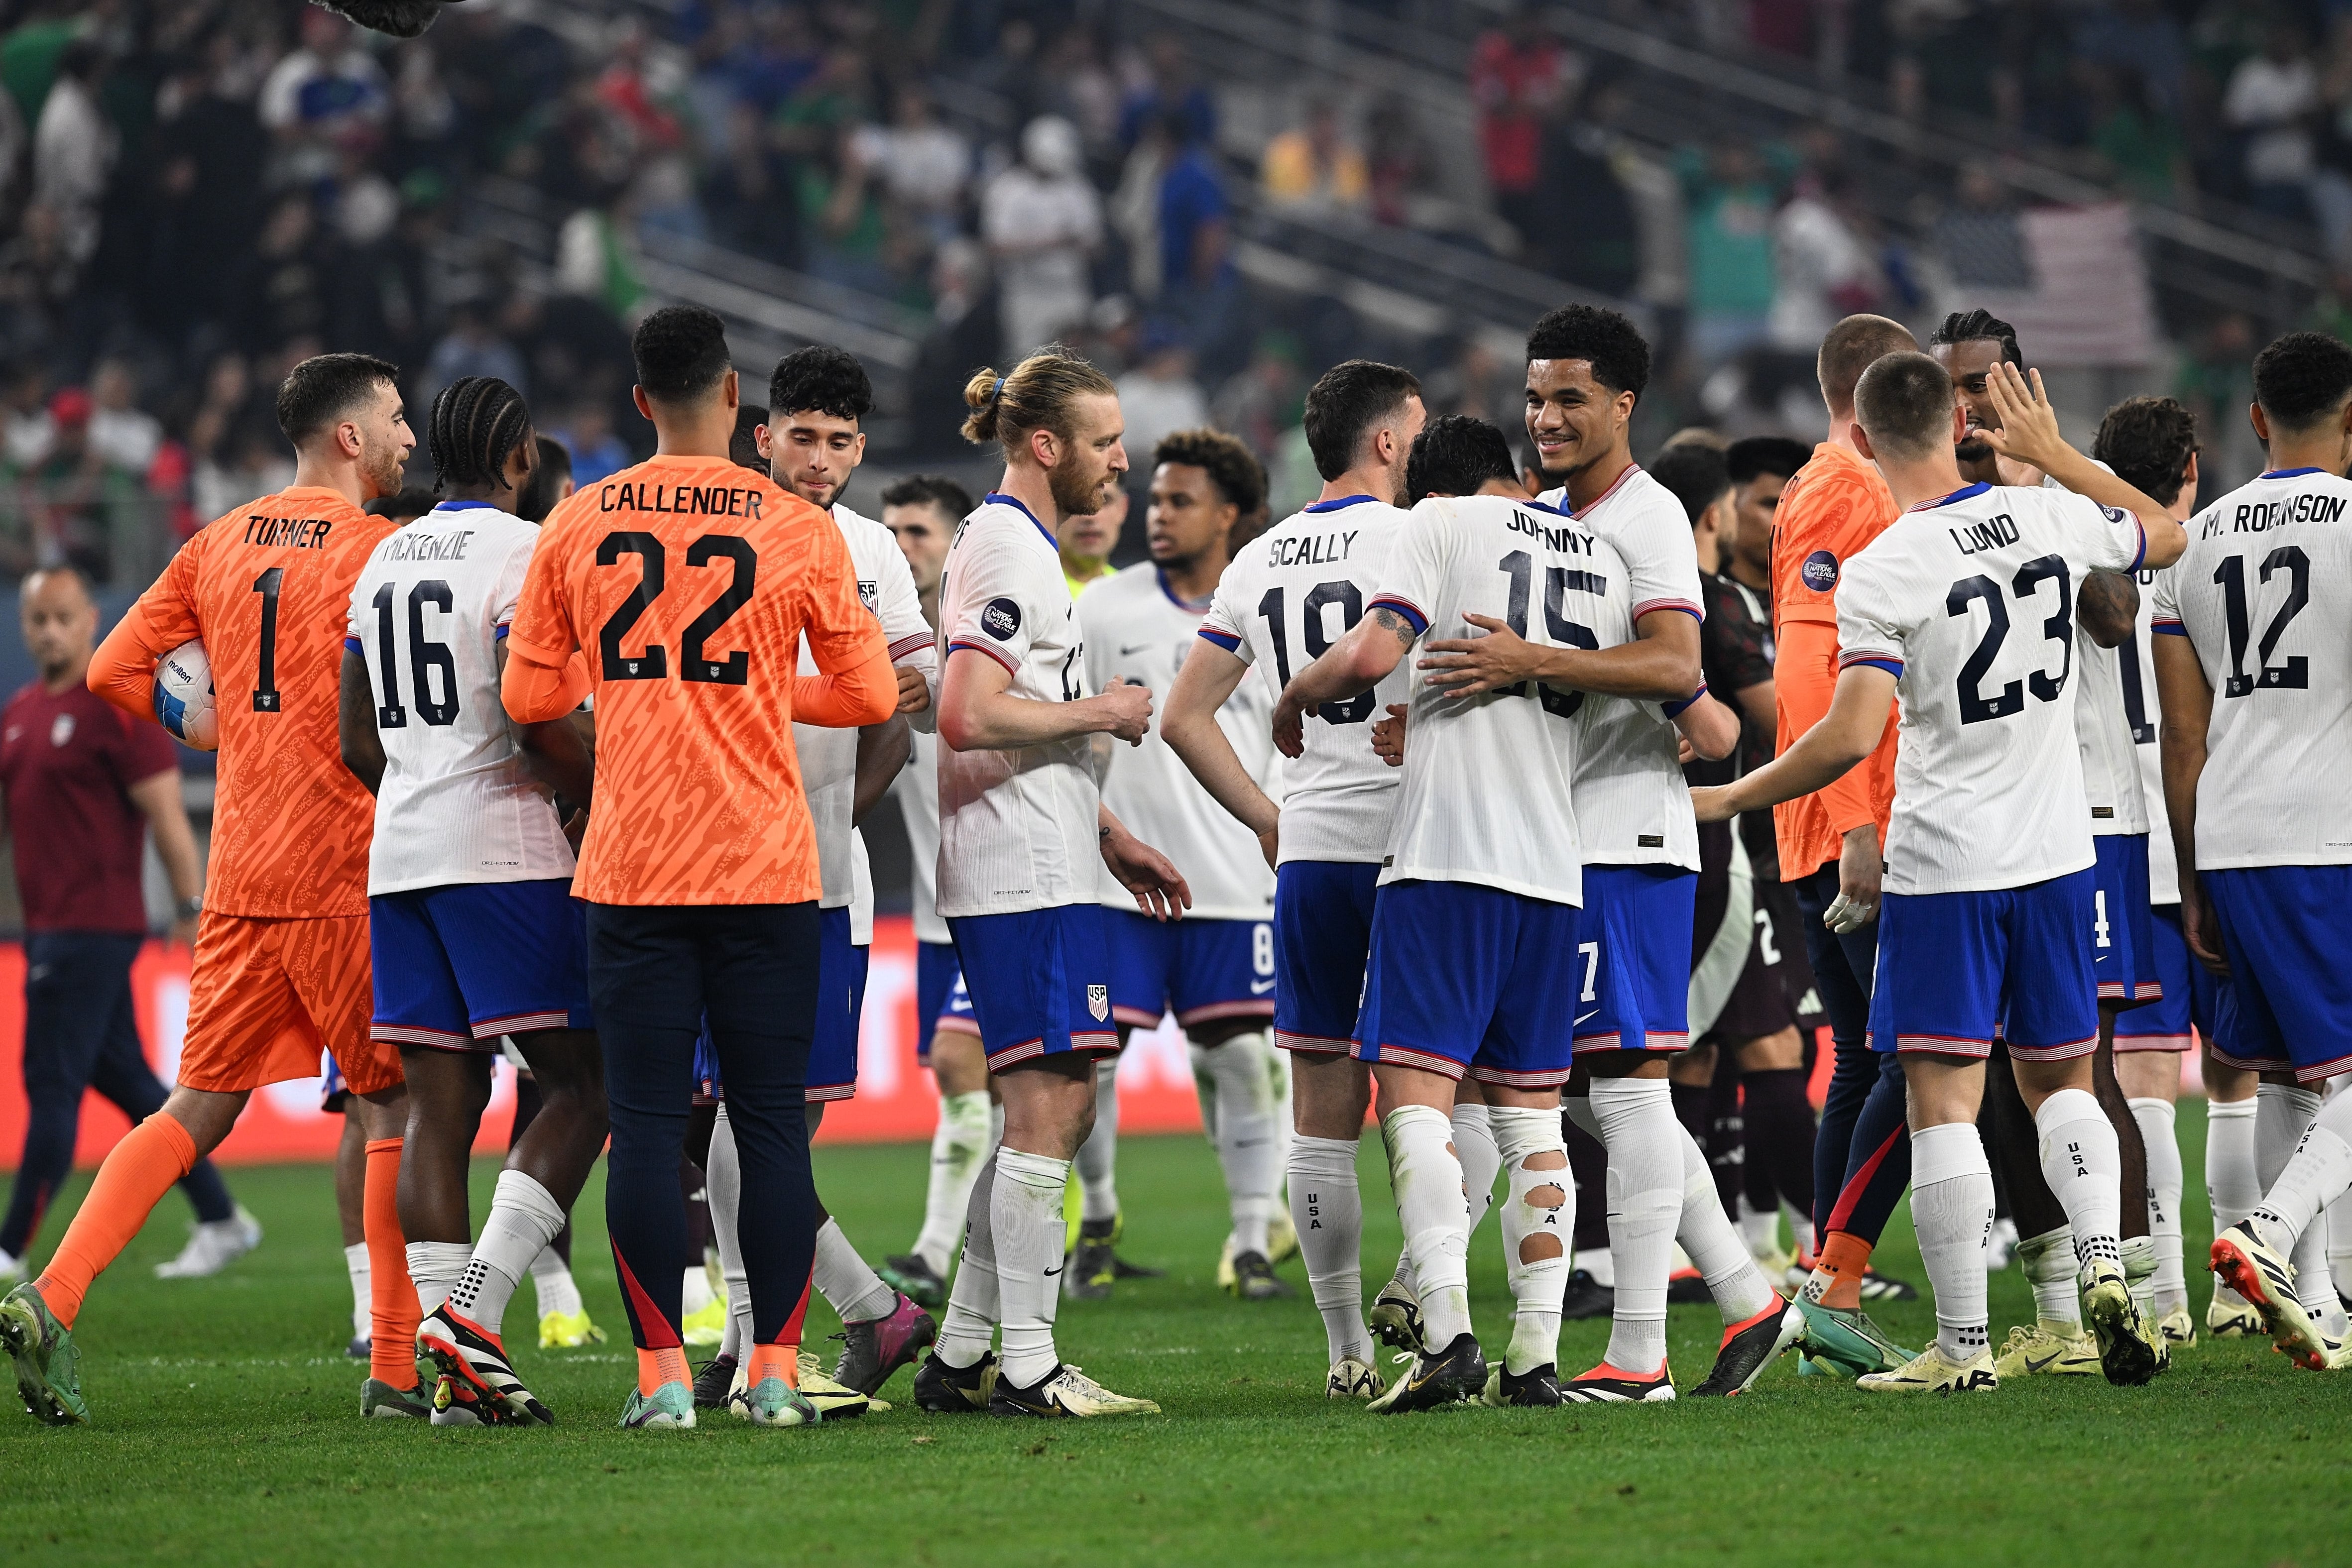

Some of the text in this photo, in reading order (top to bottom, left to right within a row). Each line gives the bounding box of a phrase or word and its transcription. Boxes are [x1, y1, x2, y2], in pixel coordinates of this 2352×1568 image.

[601, 483, 763, 520] CALLENDER
[2202, 494, 2348, 541] M. ROBINSON
[244, 515, 332, 549] TURNER
[1269, 530, 1359, 568] SCALLY
[1507, 509, 1595, 557] JOHNNY
[1949, 513, 2020, 555] LUND
[596, 531, 757, 685] 22
[860, 584, 875, 601] SA
[990, 611, 1014, 624] NATIONS
[996, 618, 1016, 631] LEAGUE
[1001, 627, 1014, 635] FINALS
[1492, 550, 1607, 719] 15
[2214, 546, 2310, 698] 12
[253, 567, 284, 713] 1
[372, 579, 460, 728] 16
[1258, 580, 1377, 730] 19
[1946, 553, 2073, 725] 23
[168, 660, 192, 683] molten
[1252, 923, 1275, 977] 8
[1754, 907, 1782, 966] 2
[1578, 941, 1599, 1003] 7
[1089, 987, 1105, 1001] USA
[2295, 1122, 2317, 1154] USA
[2068, 1142, 2089, 1177] USA
[1308, 1193, 1322, 1230] USA
[1982, 1208, 1994, 1248] USA
[961, 1220, 972, 1263] USA
[466, 1330, 482, 1342] PREDATOR
[1540, 1378, 1559, 1397] PHANTOM
